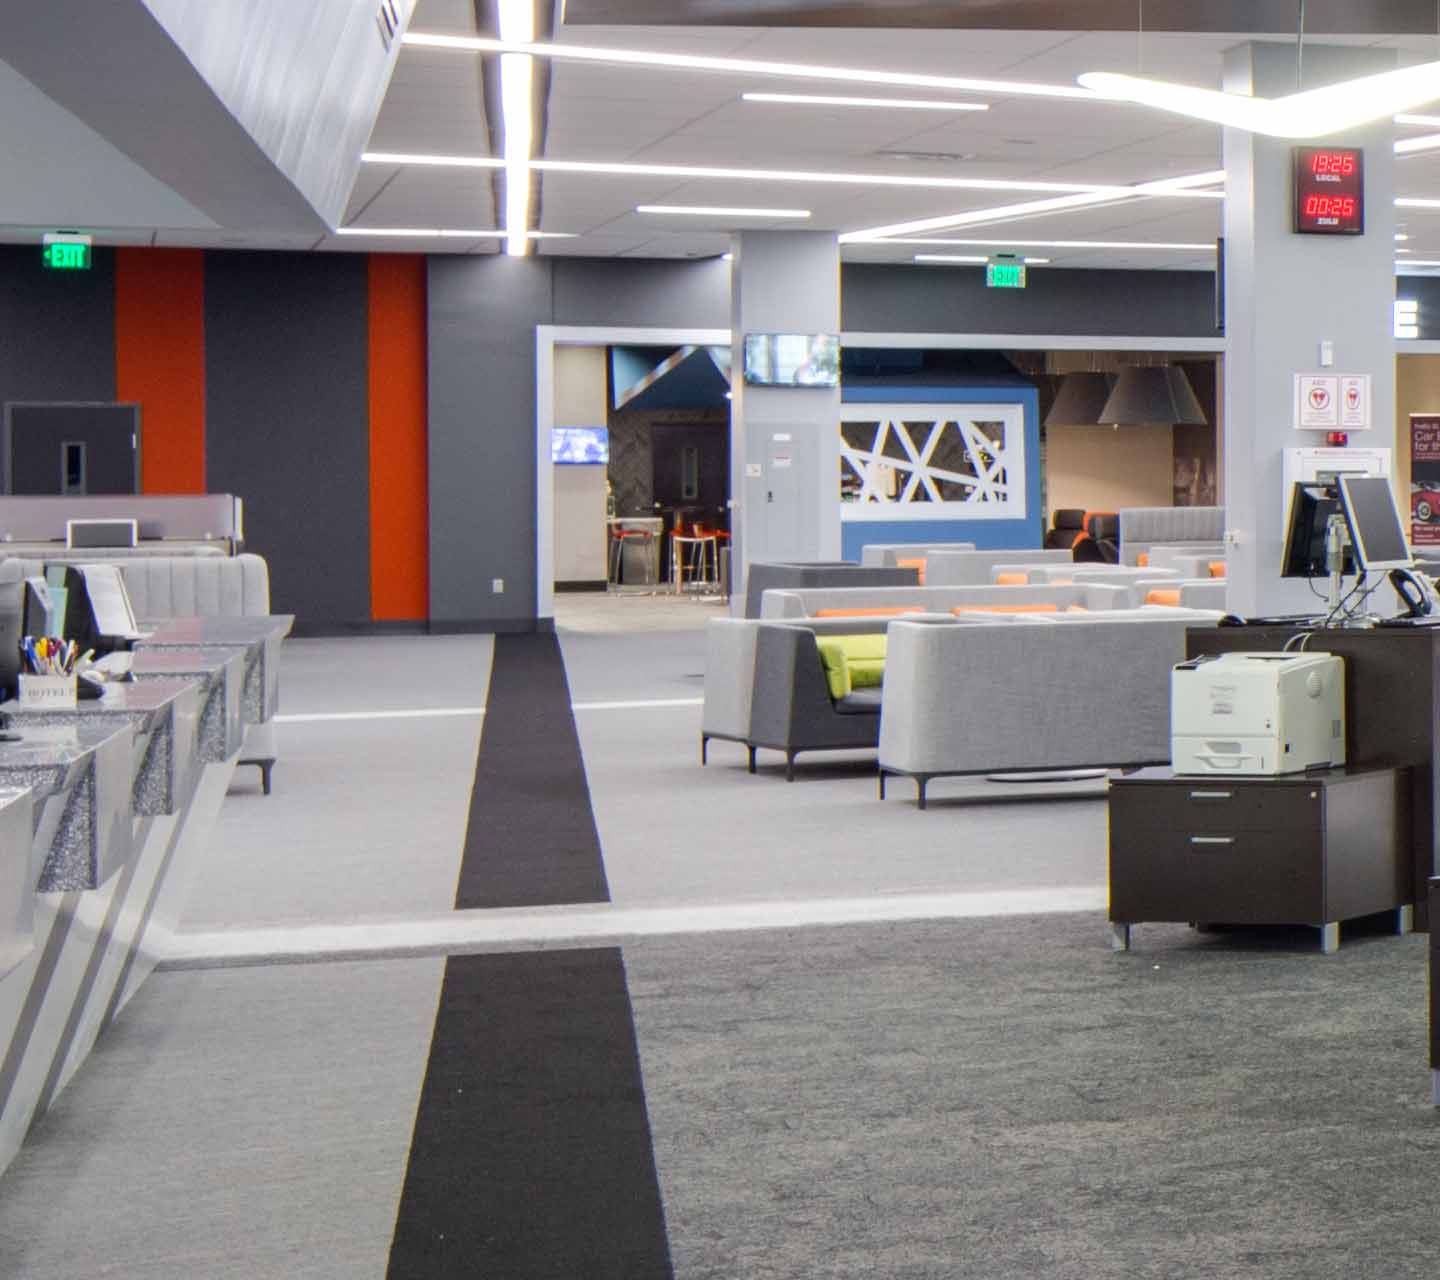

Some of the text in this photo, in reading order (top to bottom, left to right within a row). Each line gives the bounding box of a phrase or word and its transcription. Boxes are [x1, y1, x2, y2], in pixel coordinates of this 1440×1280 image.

[1306, 197, 1354, 216] 00:25
[1414, 431, 1434, 441] Car
[1415, 441, 1429, 451] for
